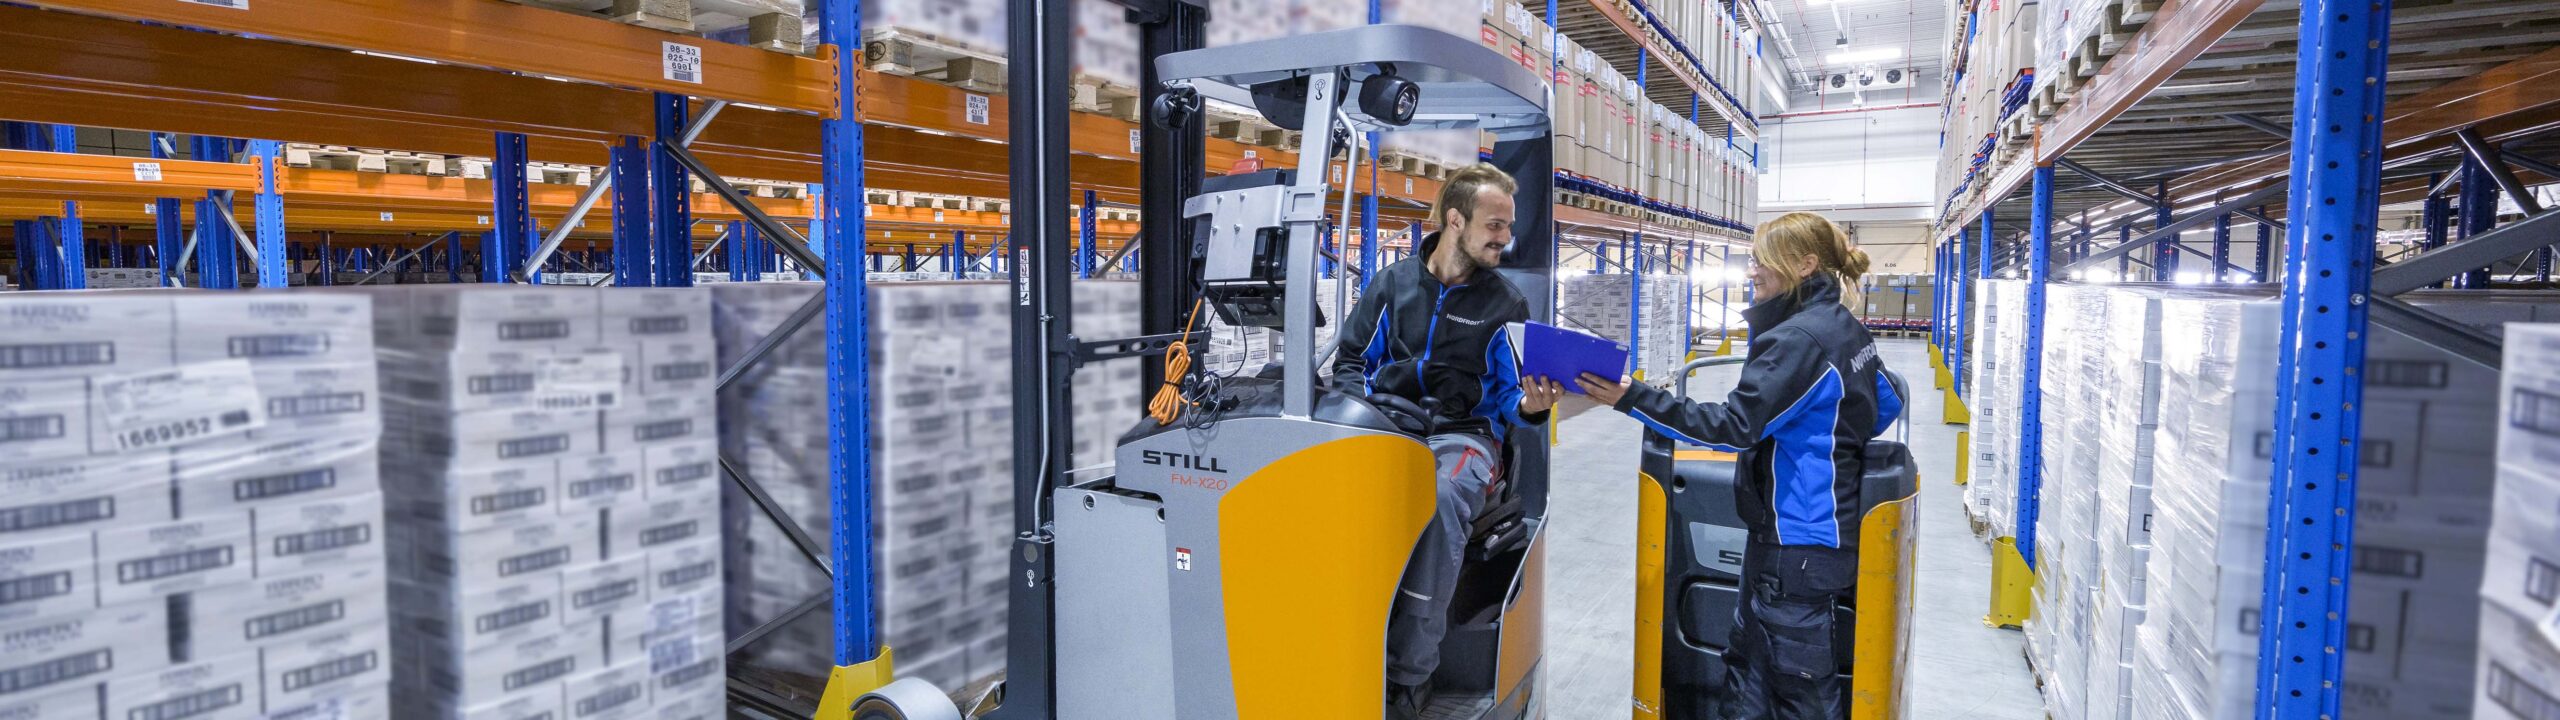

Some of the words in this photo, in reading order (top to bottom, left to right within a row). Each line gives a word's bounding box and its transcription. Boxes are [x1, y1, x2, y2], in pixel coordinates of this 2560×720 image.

[667, 53, 700, 65] 025-10
[670, 44, 696, 56] 08-33
[117, 417, 211, 449] 1669952
[1142, 449, 1228, 474] STILL
[1171, 473, 1229, 492] FM-X20
